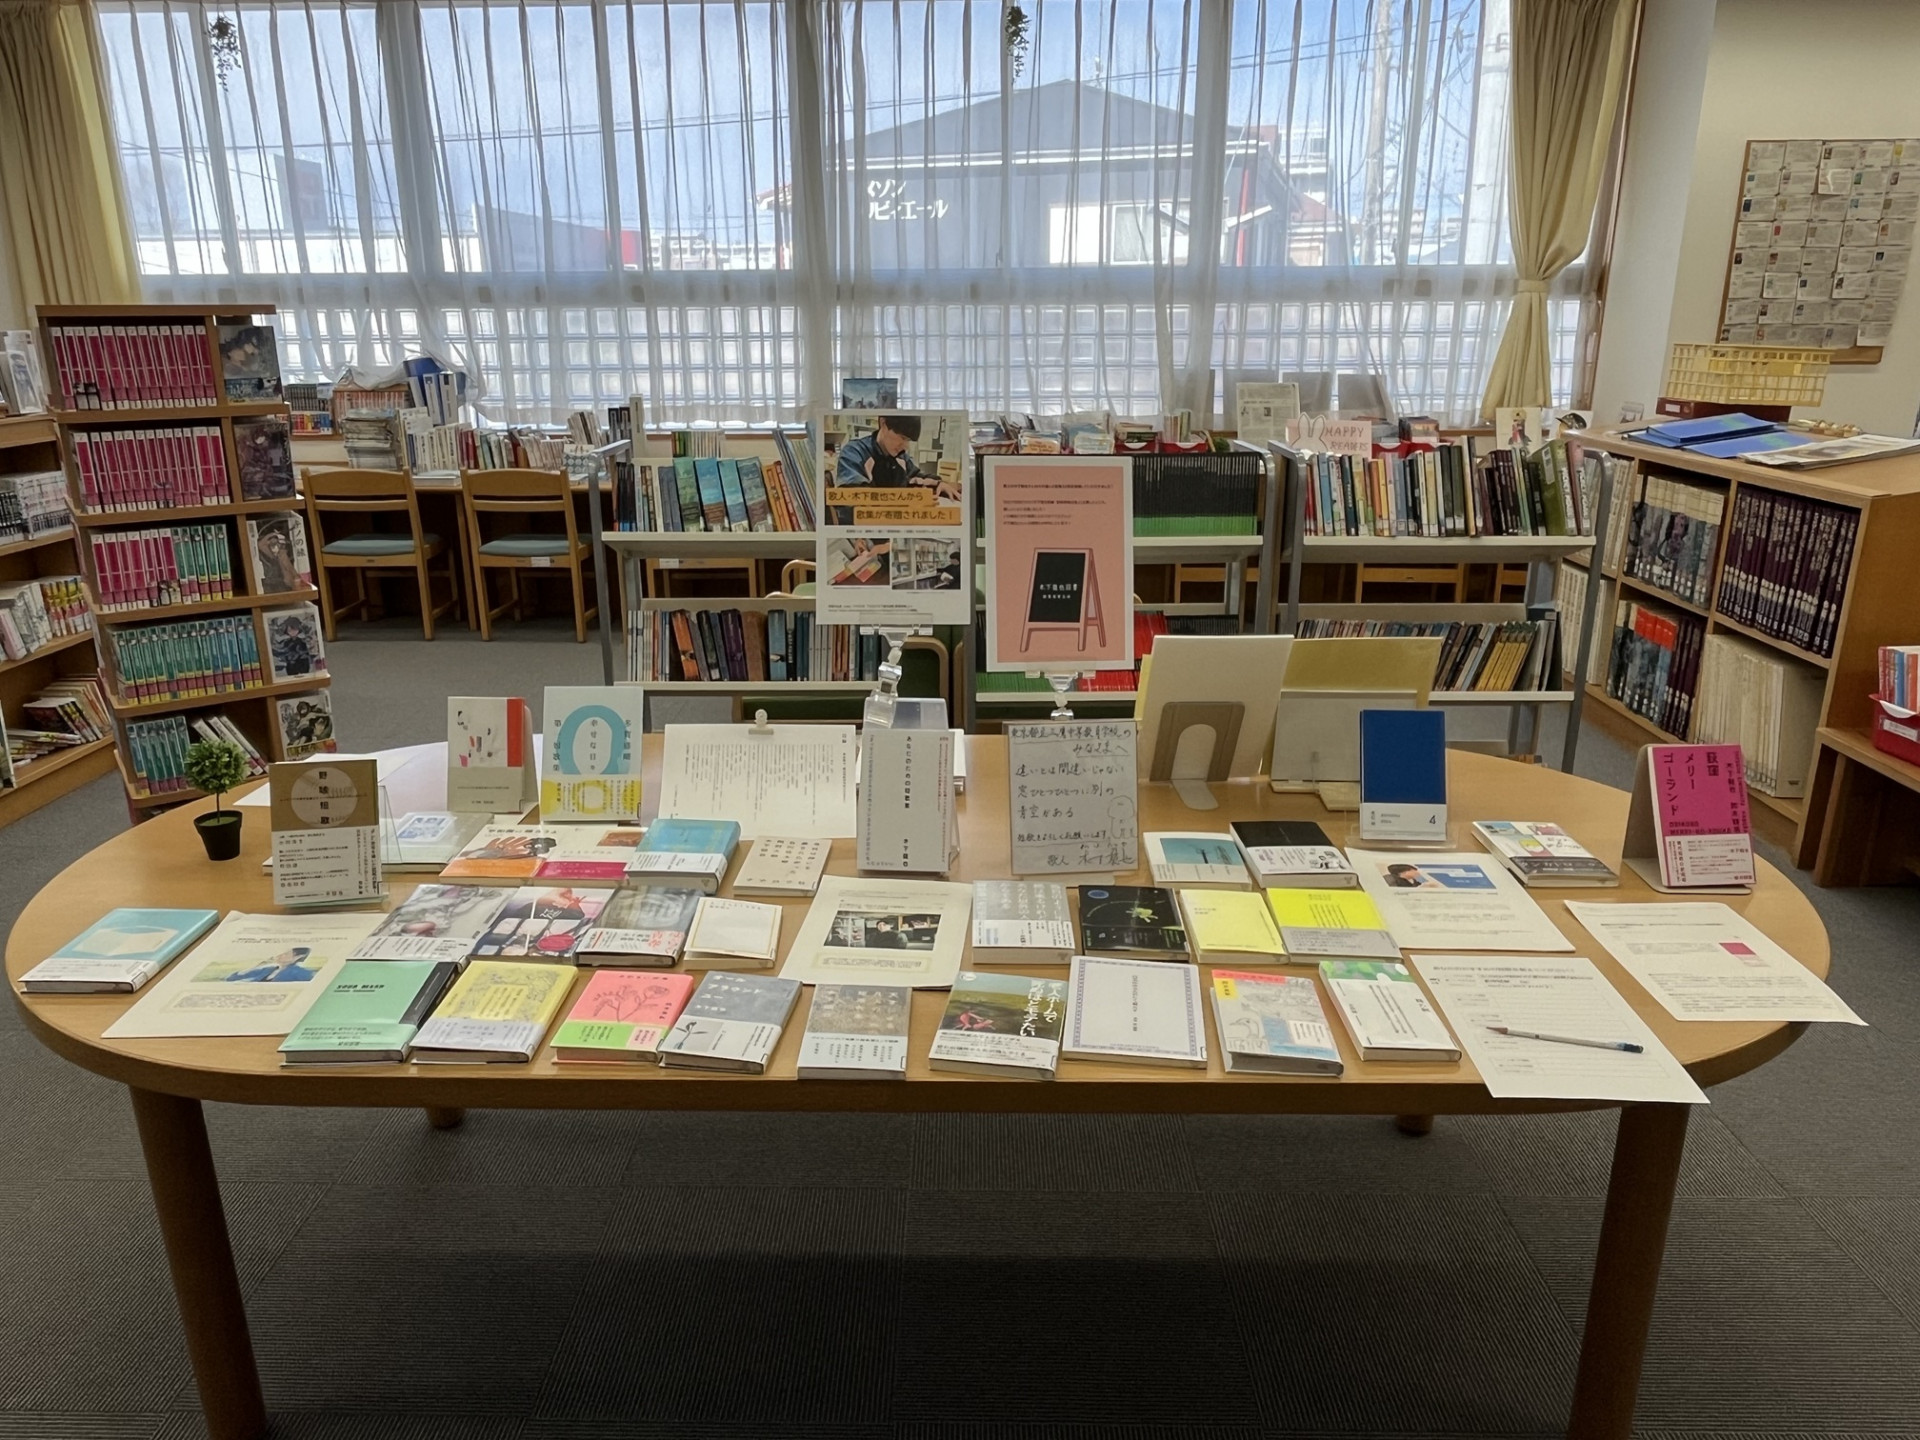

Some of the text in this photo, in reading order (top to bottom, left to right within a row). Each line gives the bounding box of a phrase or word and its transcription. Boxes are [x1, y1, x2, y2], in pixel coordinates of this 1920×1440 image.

[1325, 426, 1364, 438] HAPPY
[1684, 753, 1696, 789] メリー
[1663, 752, 1679, 816] ゴーランド
[1429, 814, 1437, 825] 4
